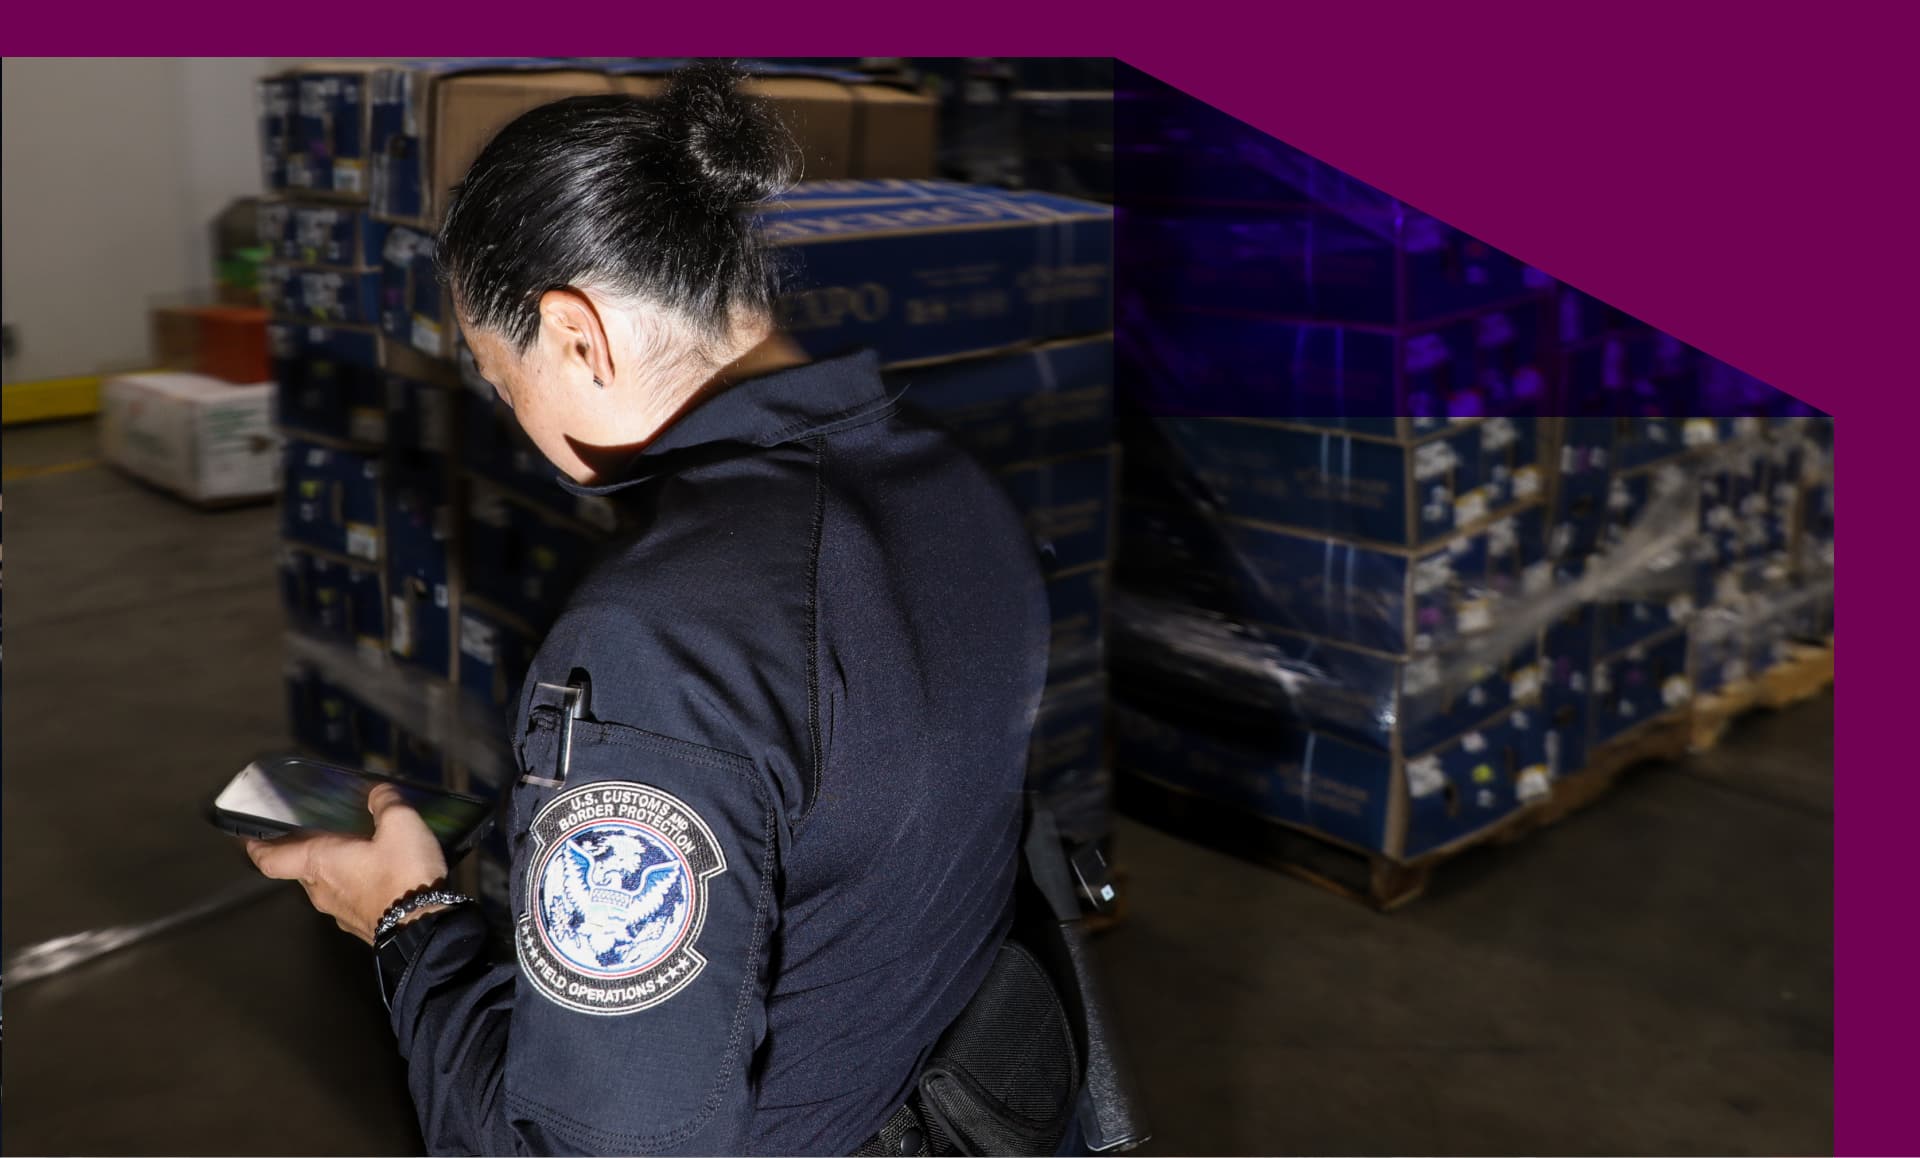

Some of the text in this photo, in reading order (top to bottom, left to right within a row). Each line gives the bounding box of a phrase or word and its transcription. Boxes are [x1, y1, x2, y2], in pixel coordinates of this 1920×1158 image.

[558, 804, 696, 855] BORDER PROTECTION
[571, 790, 689, 831] U.S. CUSTOMS AND
[535, 958, 656, 1002] FIELD OPERATIONS
